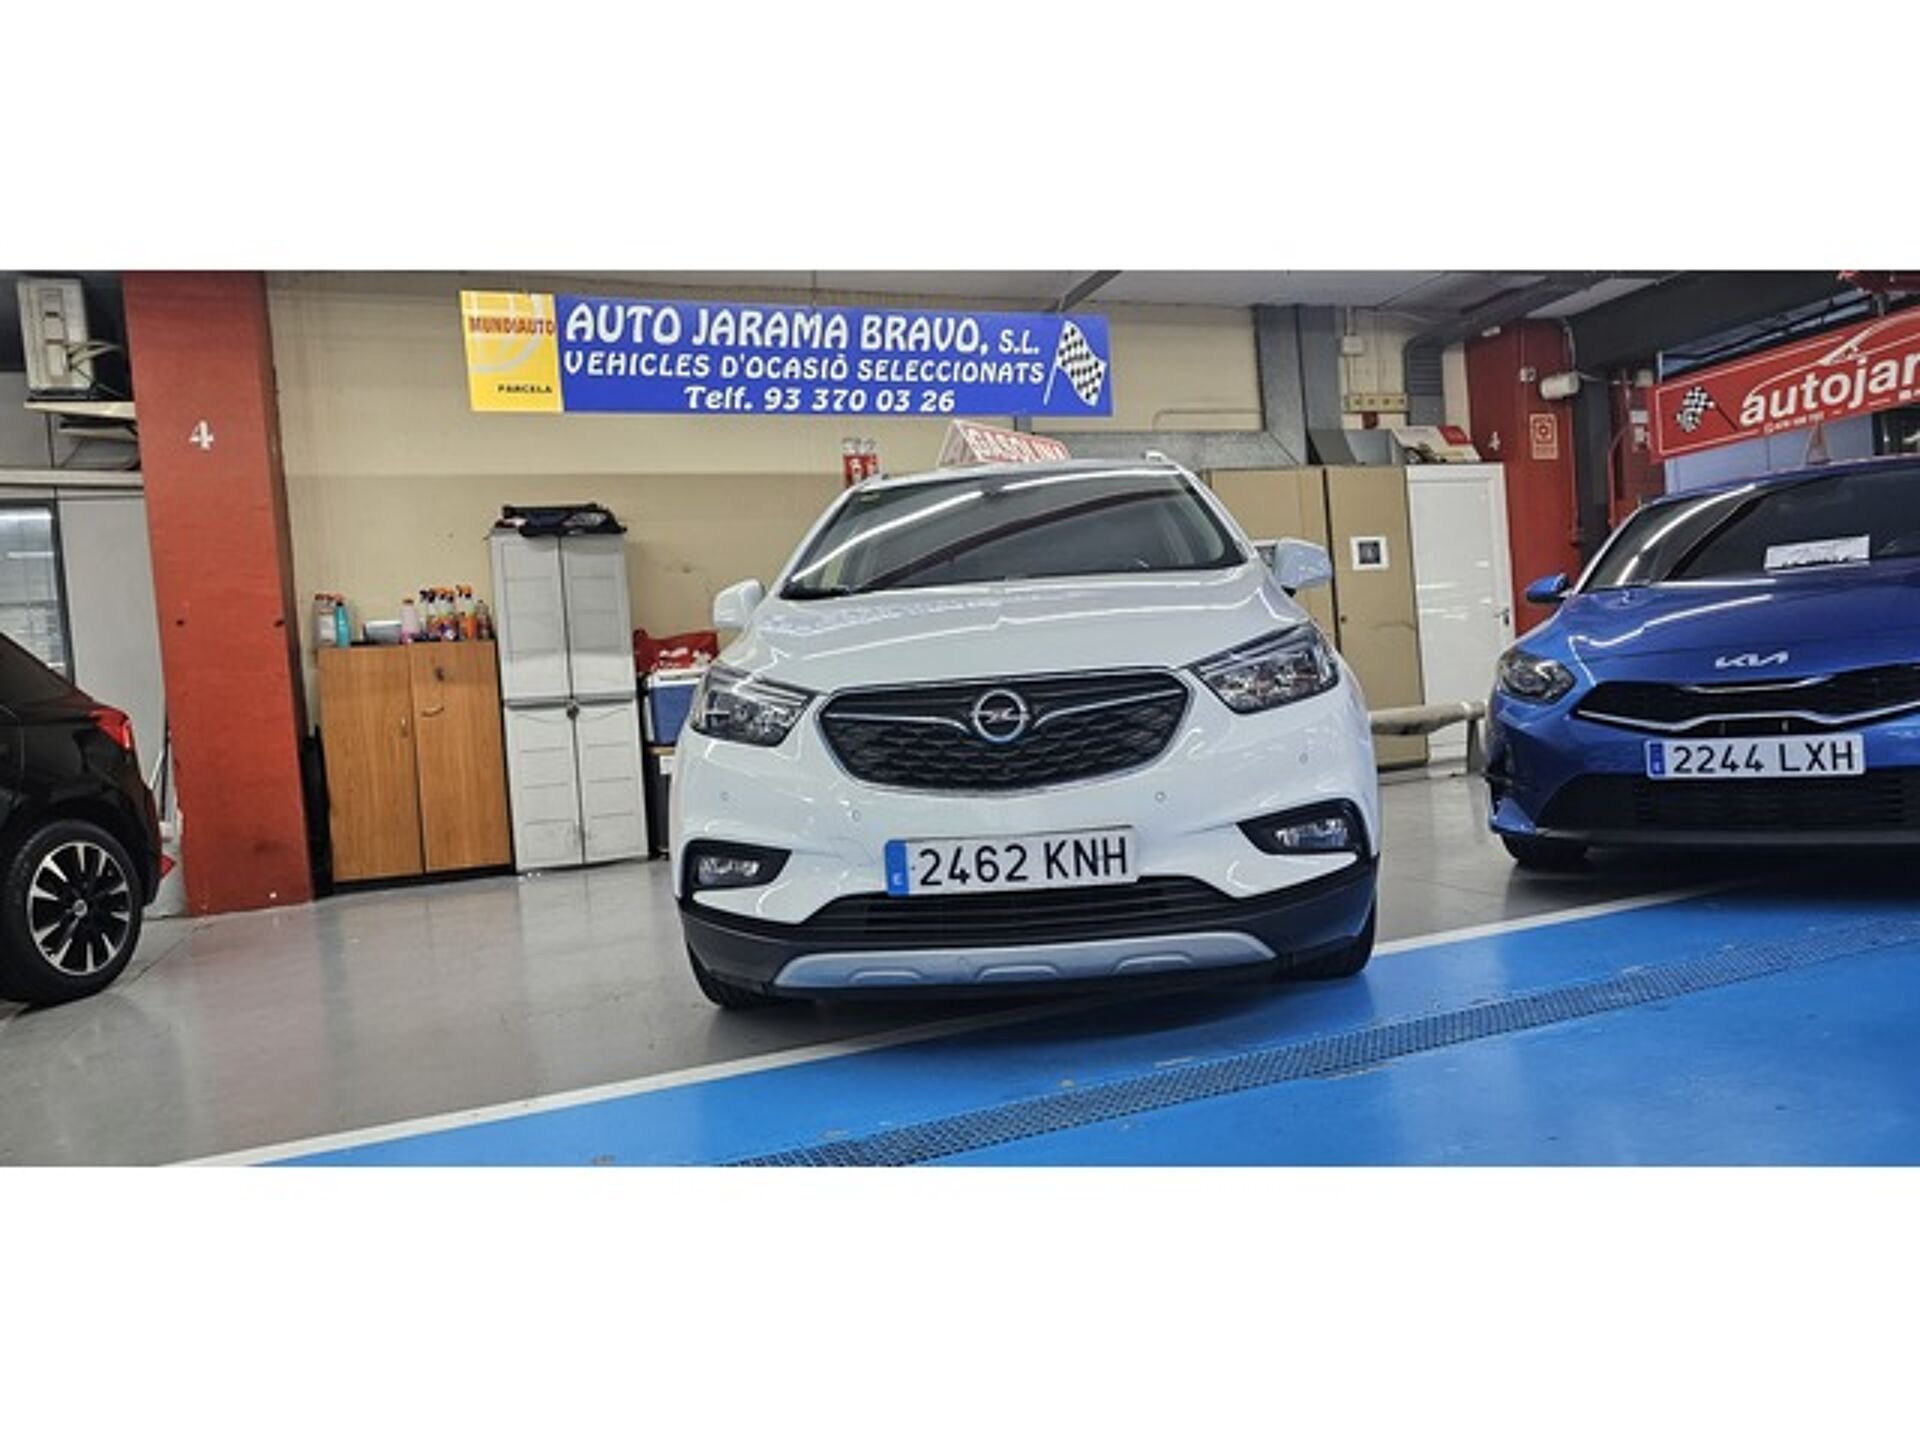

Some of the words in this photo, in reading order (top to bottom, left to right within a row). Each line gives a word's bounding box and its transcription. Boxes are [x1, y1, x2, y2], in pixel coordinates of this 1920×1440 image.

[566, 304, 681, 344] AUTO
[692, 308, 849, 349] JARAMA
[860, 314, 989, 355] BRAVO,
[998, 328, 1040, 355] S.L.
[564, 350, 710, 378] VEHICLES
[856, 358, 1045, 384] SELECCIONATS
[684, 385, 753, 410] Telf.
[763, 387, 801, 411] 93
[811, 388, 866, 412] 370
[875, 389, 911, 412] 03
[919, 389, 955, 412] 26
[189, 420, 214, 451] 4
[1673, 745, 1764, 774] 2244
[1777, 740, 1854, 771] LXH
[918, 843, 1029, 886] 2462
[1043, 836, 1127, 879] KNH
